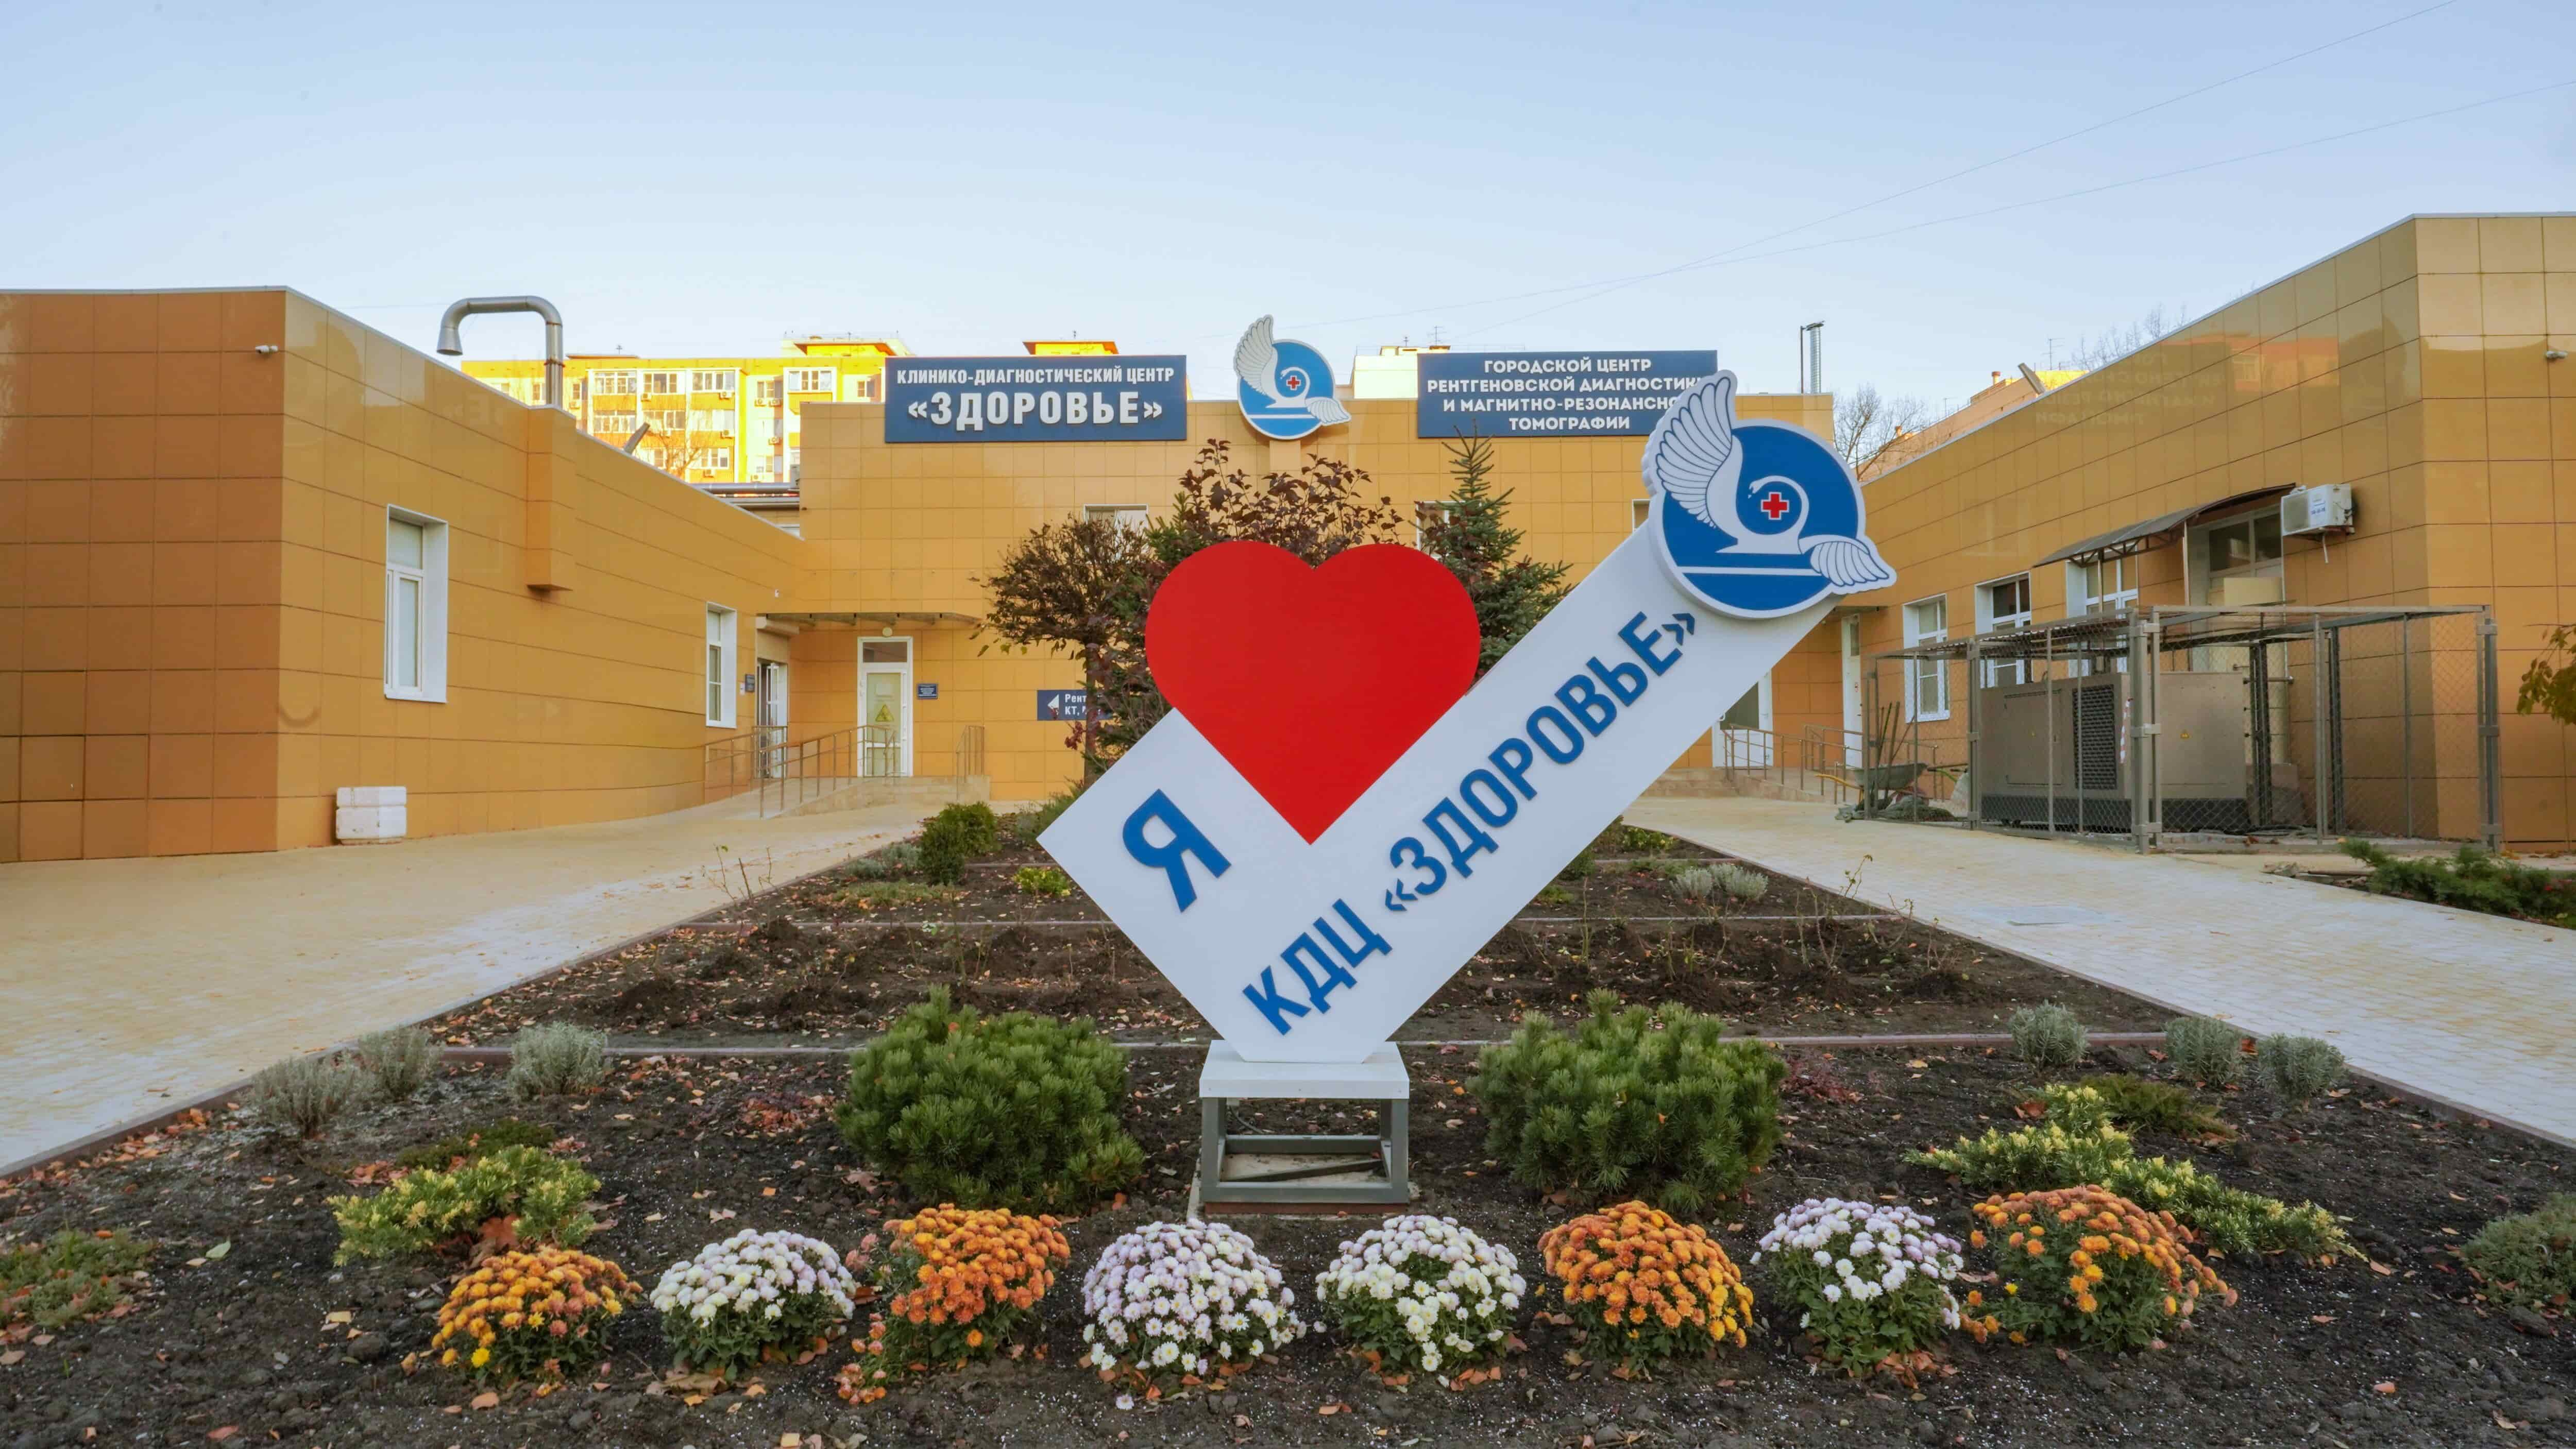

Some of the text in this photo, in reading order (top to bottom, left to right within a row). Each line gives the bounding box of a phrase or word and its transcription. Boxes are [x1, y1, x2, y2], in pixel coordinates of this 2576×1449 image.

[1484, 356, 1651, 374] ГОРОДСКОЙ ЦЕНТР
[897, 365, 1174, 386] КЛИНИКО-ДИАГНОСТИЧЕСКИЙ ЦЕНТР
[1427, 376, 1700, 393] РЕНТГЕНОВСКОЙ ДИАГНОСТИК
[908, 391, 1162, 431] «ЗДОРОВЬЕ»
[1444, 397, 1679, 412] И МАГНИТНО-РЕЗОНАНСНО
[1509, 416, 1630, 430] ТОМОГРАФИИ
[1064, 693, 1087, 703] Рент
[1064, 706, 1080, 716] КТ,
[1243, 612, 1695, 1036] КДЦ «ЗДОРОВЬЕ»
[1122, 789, 1231, 912] Я
